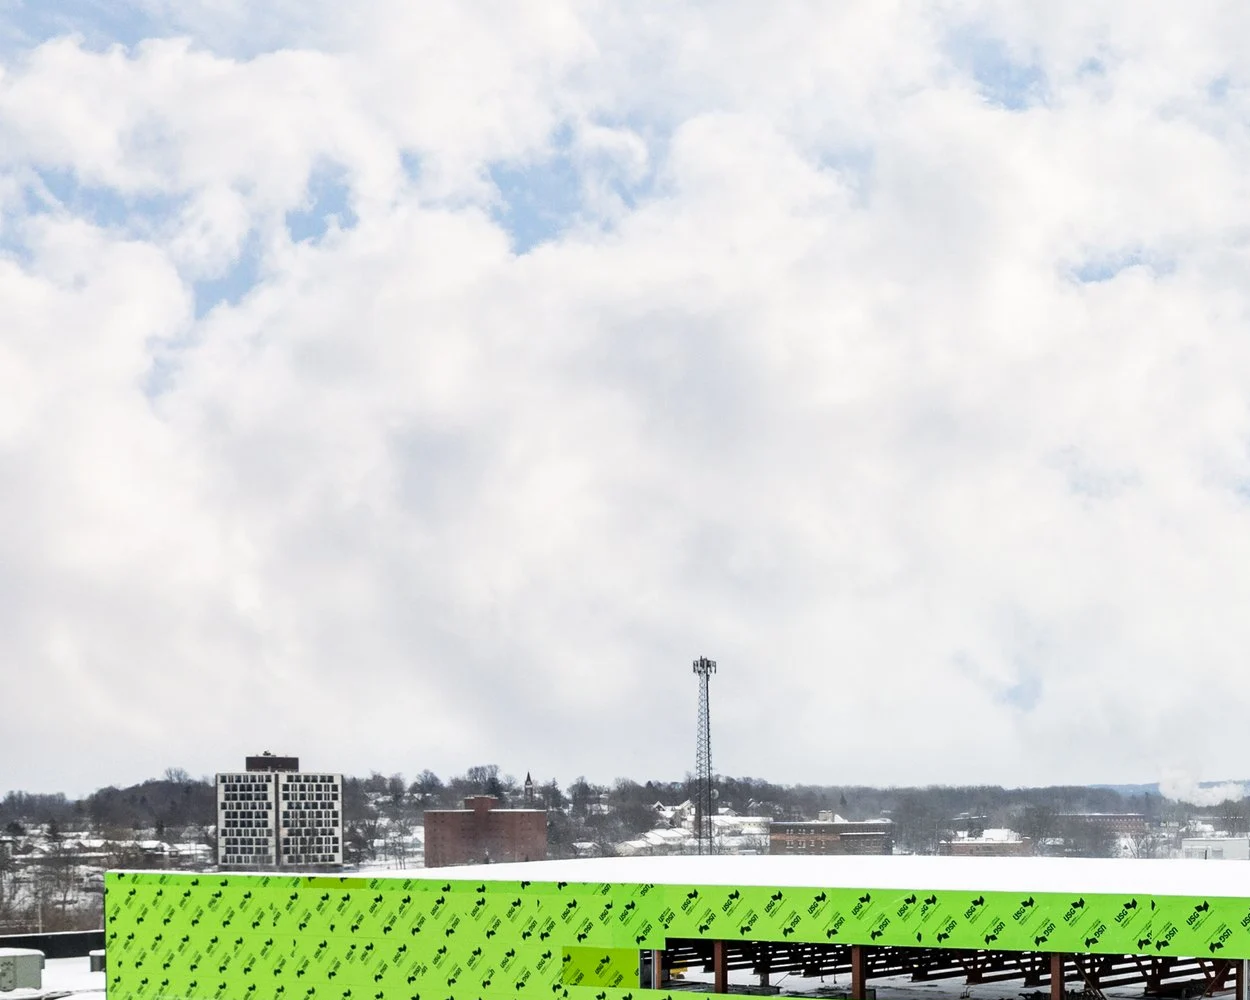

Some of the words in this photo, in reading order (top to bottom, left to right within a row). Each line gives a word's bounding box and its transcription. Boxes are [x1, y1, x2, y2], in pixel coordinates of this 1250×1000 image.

[808, 902, 818, 914] USG
[852, 903, 863, 915] USG
[897, 904, 908, 917] USG
[964, 906, 976, 919] USG
[1013, 907, 1025, 920] USG
[1063, 908, 1076, 921] USG
[706, 913, 716, 925] USG
[1114, 909, 1128, 923] USG
[1186, 912, 1199, 925] USG
[945, 920, 957, 933] USG
[993, 922, 1005, 935] USG
[1043, 923, 1055, 936] USG
[1094, 925, 1106, 938] USG
[1165, 927, 1178, 941] USG
[1219, 929, 1232, 942] USG
